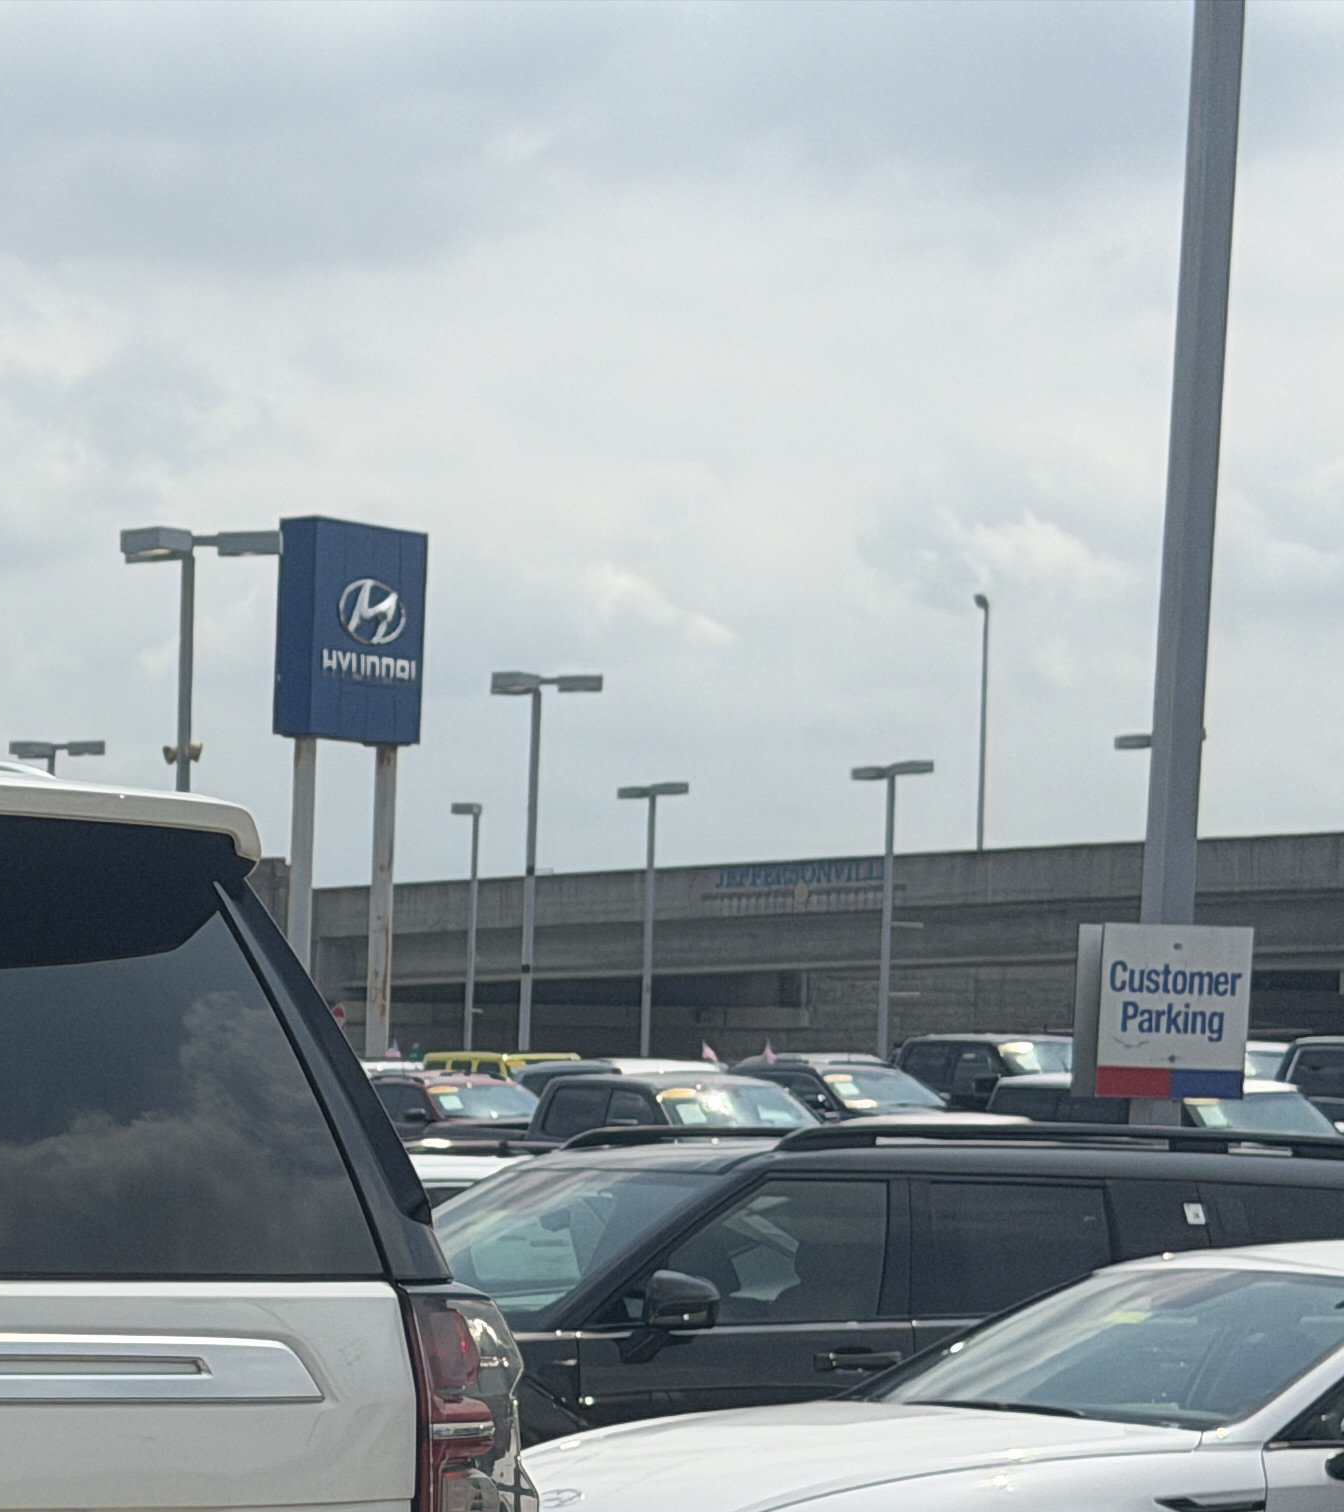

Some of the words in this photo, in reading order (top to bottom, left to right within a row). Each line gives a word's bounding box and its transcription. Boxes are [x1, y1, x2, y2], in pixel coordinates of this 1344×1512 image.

[322, 648, 416, 681] HYUNDAI
[715, 861, 885, 887] JEFFERSONVILL
[1109, 960, 1242, 997] Customer
[1121, 1001, 1224, 1042] Parking
